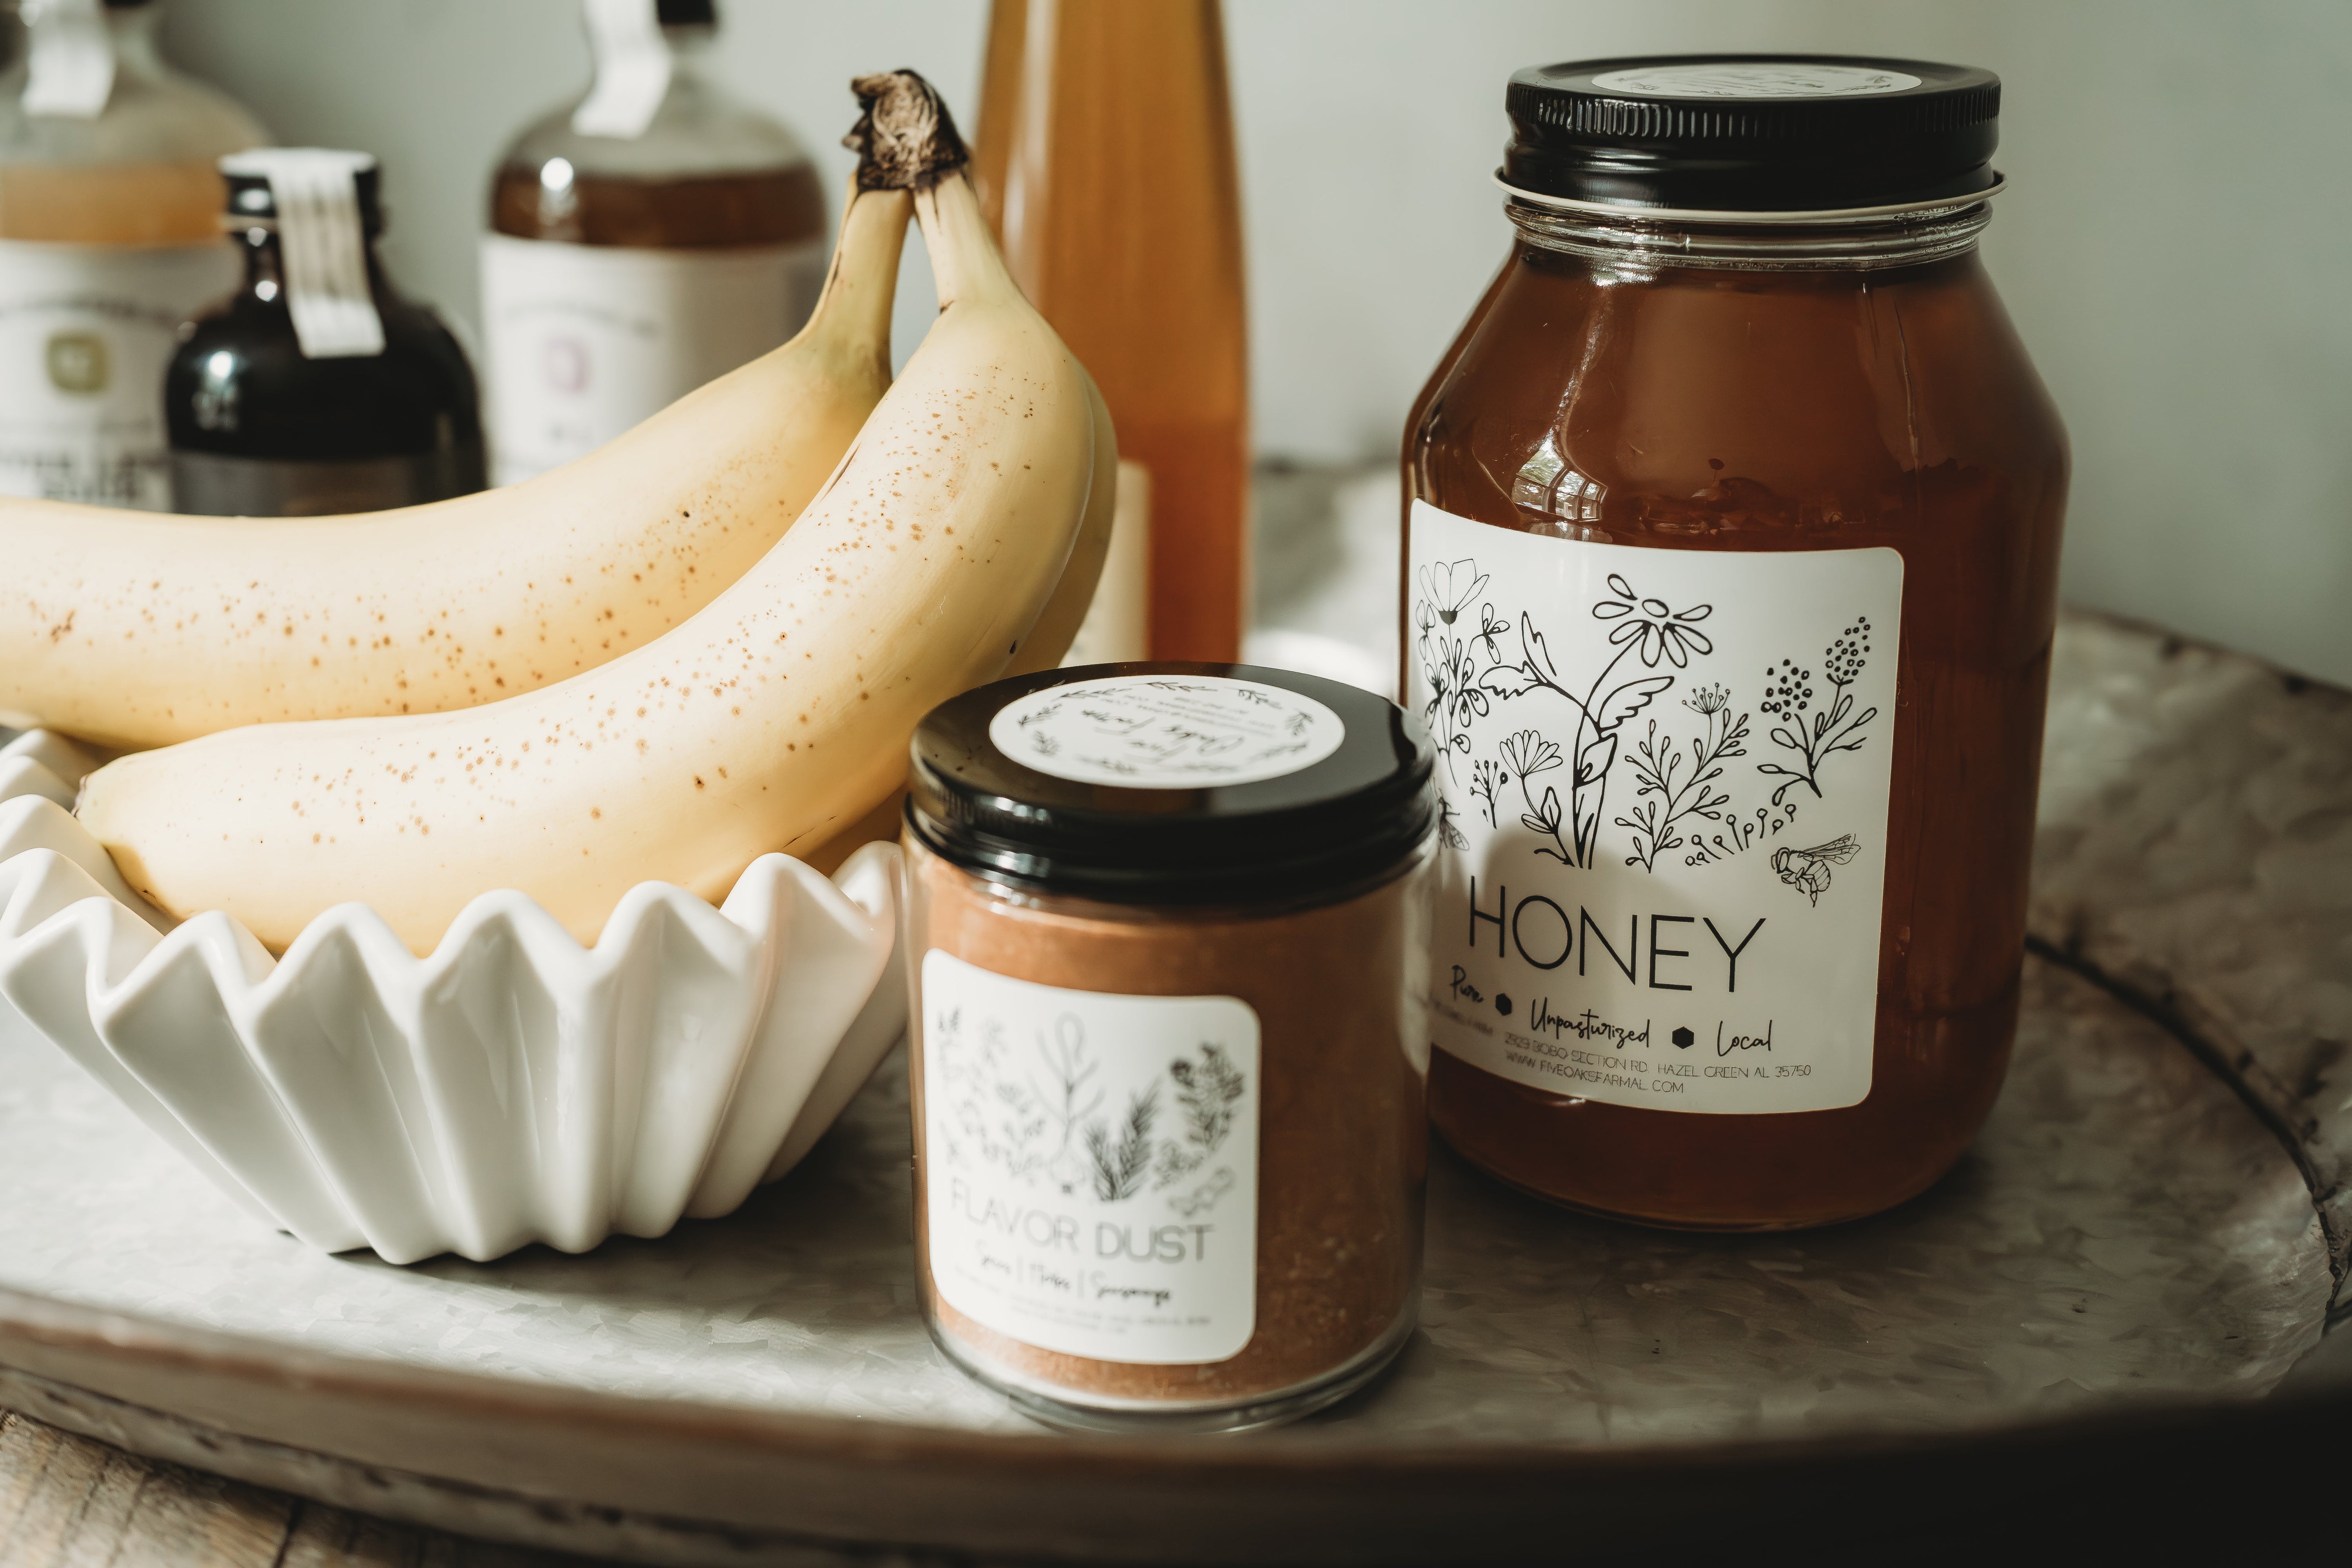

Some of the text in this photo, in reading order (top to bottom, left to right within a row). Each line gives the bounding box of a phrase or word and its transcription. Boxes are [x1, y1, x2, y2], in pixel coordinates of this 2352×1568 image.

[1470, 875, 1767, 993] HONEY
[1531, 996, 1650, 1049] Unpasturized
[1717, 1019, 1773, 1057] Local
[1570, 1049, 1626, 1070] SECTION
[1658, 1063, 1700, 1077] HAZEL
[1754, 1065, 1770, 1078] AL
[1774, 1064, 1811, 1078] 35750
[949, 1174, 1217, 1265] FLAVOR DUST
